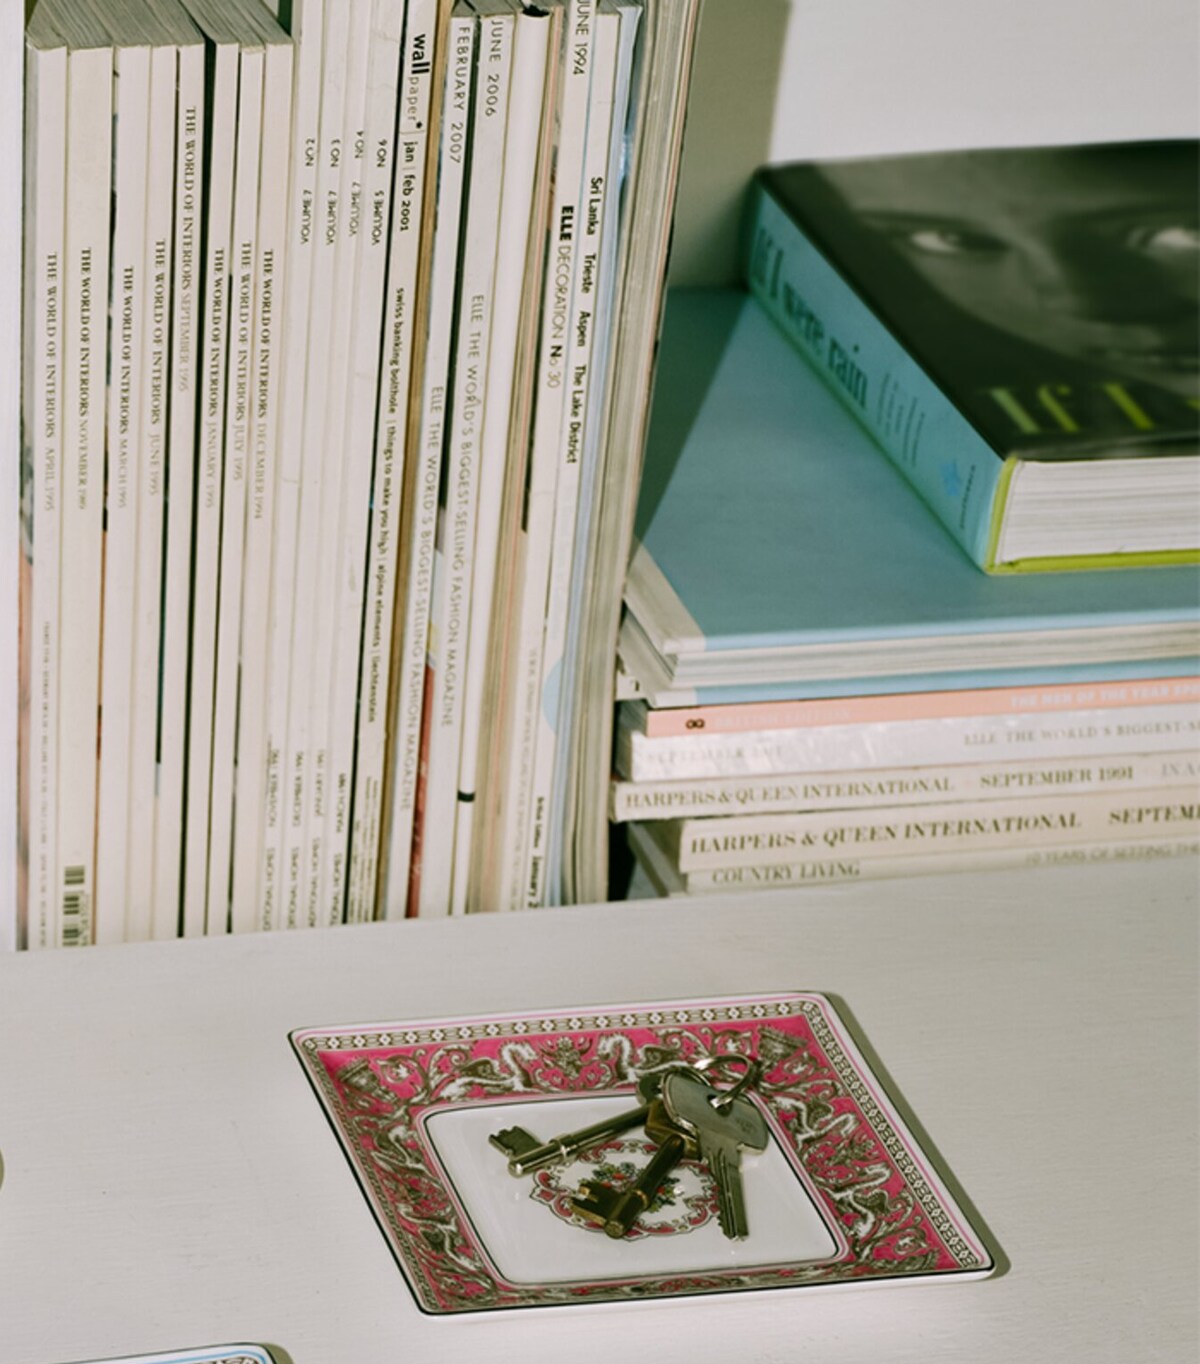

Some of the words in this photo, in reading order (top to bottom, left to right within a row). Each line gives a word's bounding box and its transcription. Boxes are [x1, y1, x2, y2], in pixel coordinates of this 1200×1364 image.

[574, 0, 591, 35] JUNE
[487, 19, 504, 62] JUNE
[572, 42, 587, 75] 1994
[454, 26, 470, 110] FEBRUARY
[484, 73, 500, 117] 2006
[185, 106, 196, 134] THE
[305, 146, 314, 166] NO
[330, 147, 340, 167] NO
[354, 139, 364, 158] NO
[376, 147, 386, 167] NO
[402, 140, 420, 164] jan
[449, 121, 463, 163] 2007
[183, 139, 195, 191] WORLD
[183, 193, 194, 211] OF
[402, 172, 416, 198] feb
[590, 176, 603, 194] Sri
[300, 199, 311, 243] VOLUME
[326, 200, 336, 244] VOLUME
[349, 190, 361, 236] VOLUME
[371, 200, 383, 245] VOLUME
[400, 200, 412, 232] 2001
[558, 204, 574, 241] ELLE
[586, 198, 600, 235] Lanka
[46, 252, 57, 280] THE
[80, 247, 91, 273] THE
[154, 238, 165, 267] THE
[181, 216, 193, 290] INTERIORS
[213, 247, 224, 274] THE
[240, 241, 251, 268] THE
[262, 248, 273, 275] THE
[123, 265, 133, 291] THE
[550, 244, 571, 339] DECORATION
[581, 253, 596, 293] Trieste
[46, 285, 56, 337] WORLD
[80, 276, 90, 324] WORLD
[153, 271, 164, 324] WORLD
[211, 276, 223, 324] WORLD
[238, 272, 250, 323] WORLD
[261, 278, 272, 326] WORLD
[394, 287, 405, 319] swiss
[470, 293, 484, 323] ELLE
[80, 325, 90, 343] OF
[121, 295, 132, 342] WORLD
[152, 326, 163, 344] OF
[179, 292, 191, 364] SEPTEMBER
[211, 325, 221, 343] OF
[238, 326, 248, 344] OF
[260, 327, 270, 344] OF
[576, 311, 590, 346] Aspen
[46, 340, 56, 358] OF
[121, 343, 131, 361] OF
[389, 320, 403, 366] banking
[467, 330, 481, 358] THE
[549, 344, 562, 367] No
[79, 347, 89, 416] INTERIORS
[150, 350, 162, 425] INTERIORS
[208, 346, 220, 417] INTERIORS
[235, 349, 247, 421] INTERIORS
[257, 348, 269, 418] INTERIORS
[387, 367, 400, 414] bolthole
[546, 370, 561, 389] 30
[573, 364, 586, 385] The
[826, 336, 870, 410] rain
[45, 364, 56, 438] INTERIORS
[119, 364, 130, 434] INTERIORS
[461, 364, 478, 437] WORLD'S
[571, 389, 583, 417] Lake
[382, 425, 396, 461] things
[566, 421, 581, 463] District
[446, 576, 463, 644] FASHION
[441, 648, 458, 727] MAGAZINE
[626, 789, 716, 807] HARPERS
[734, 785, 797, 805] QUEEN
[802, 777, 954, 798] INTERNATIONAL
[980, 768, 1091, 787] SEPTEMBER
[690, 831, 796, 853] HARPERS
[800, 832, 815, 845] &
[822, 825, 896, 844] QUEEN
[904, 812, 1081, 839] INTERNATIONAL
[1109, 804, 1200, 824] SEPTEM
[711, 864, 791, 884] COUNTRY
[799, 861, 860, 879] LIVING
